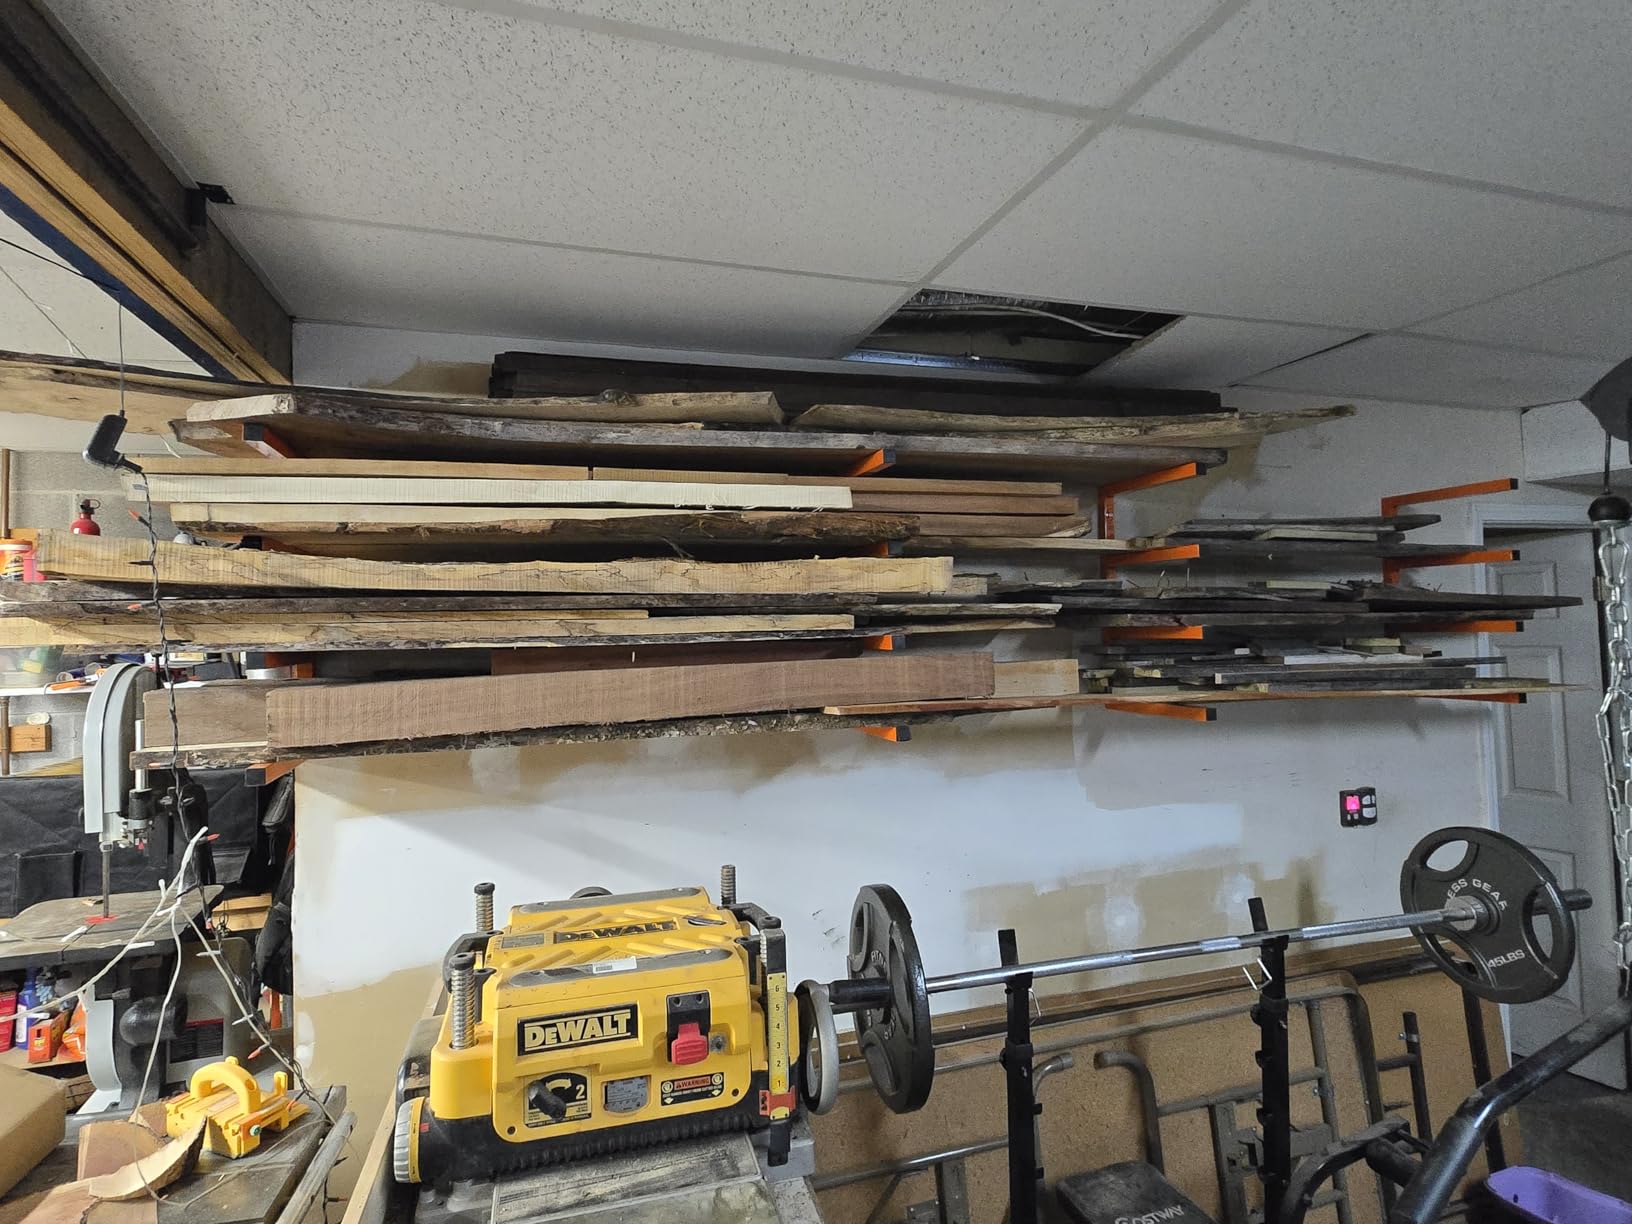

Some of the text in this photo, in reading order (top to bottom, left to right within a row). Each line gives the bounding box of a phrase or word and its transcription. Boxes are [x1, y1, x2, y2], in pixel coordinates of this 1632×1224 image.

[1487, 949, 1526, 968] 45LBS
[524, 1013, 631, 1048] DEWALT
[575, 1084, 586, 1100] 2
